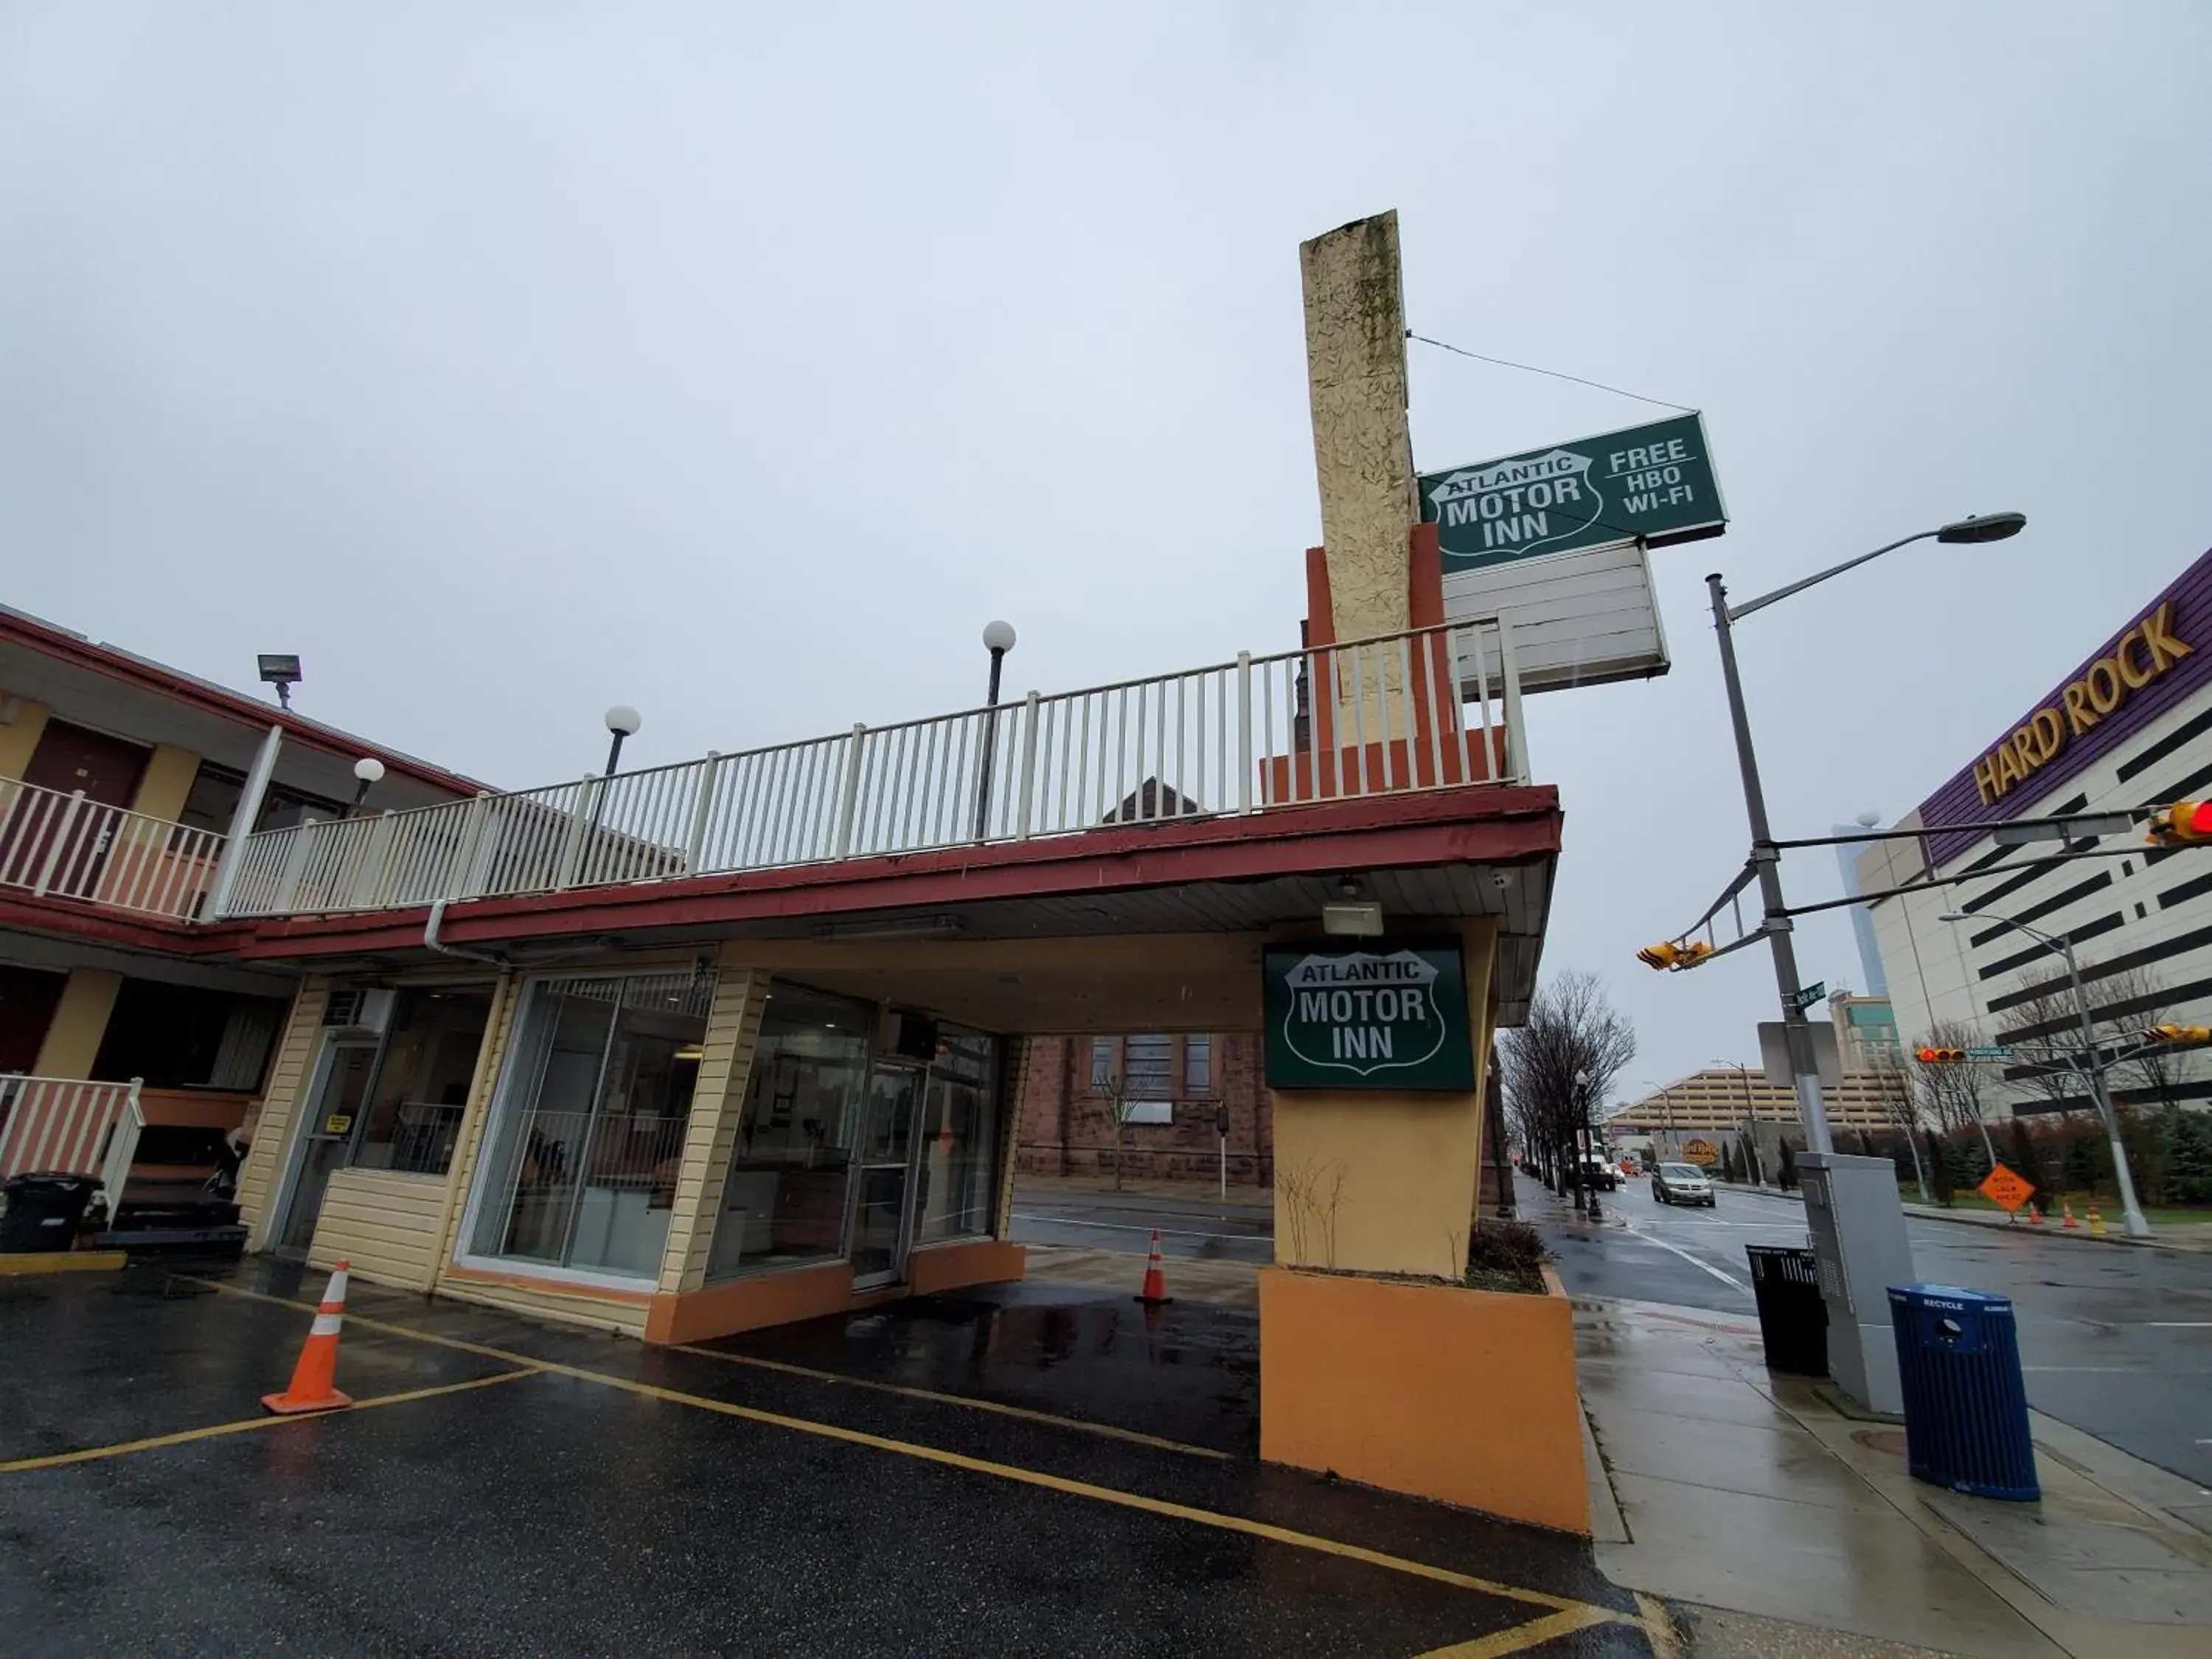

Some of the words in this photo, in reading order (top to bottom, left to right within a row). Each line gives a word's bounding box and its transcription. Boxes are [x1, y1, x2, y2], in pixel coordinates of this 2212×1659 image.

[1609, 439, 1687, 474] FREE
[1447, 456, 1573, 496] ATLANTIC
[1627, 466, 1681, 493] HBO
[1446, 476, 1582, 528] MOTOR
[1622, 484, 1694, 515] WI-FI
[1482, 511, 1549, 548] INN
[1972, 707, 2065, 807] HARD
[2062, 601, 2196, 737] ROCK
[1301, 961, 1420, 983] ATLANTIC
[1299, 988, 1426, 1023] MOTOR
[1332, 1026, 1393, 1059] INN
[1923, 1298, 1964, 1310] RECYCLE
